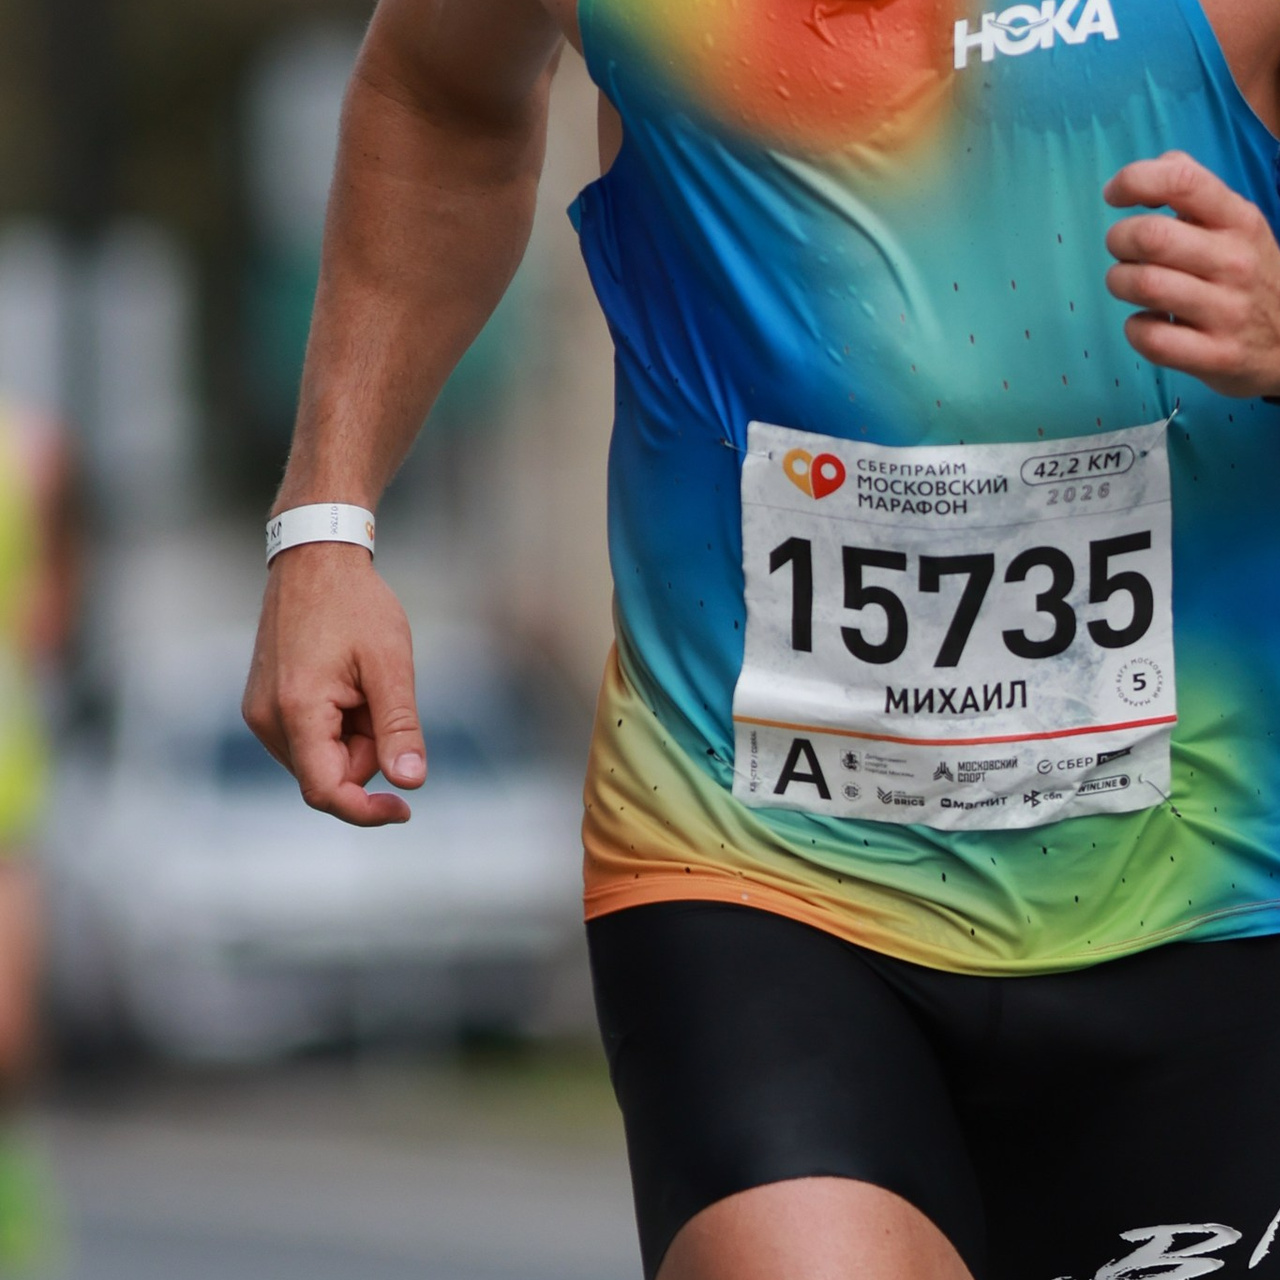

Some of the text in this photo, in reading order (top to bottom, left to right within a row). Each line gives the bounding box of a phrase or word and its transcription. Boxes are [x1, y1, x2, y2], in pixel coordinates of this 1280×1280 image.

[856, 458, 967, 476] СБЕРПРАЙМ
[1033, 452, 1122, 478] 42,2 КМ
[857, 475, 1008, 496] МОСКОВСКИЙ
[858, 493, 968, 515] МАРАФОН
[769, 530, 1154, 668] 15735
[1132, 672, 1147, 691] 5
[885, 680, 1028, 715] МИХАИЛ
[957, 756, 1018, 771] МОСКОВСКИЙ
[1057, 757, 1093, 771] СБЕР
[957, 772, 986, 783] СПОРТ
[894, 797, 925, 807] BRICS
